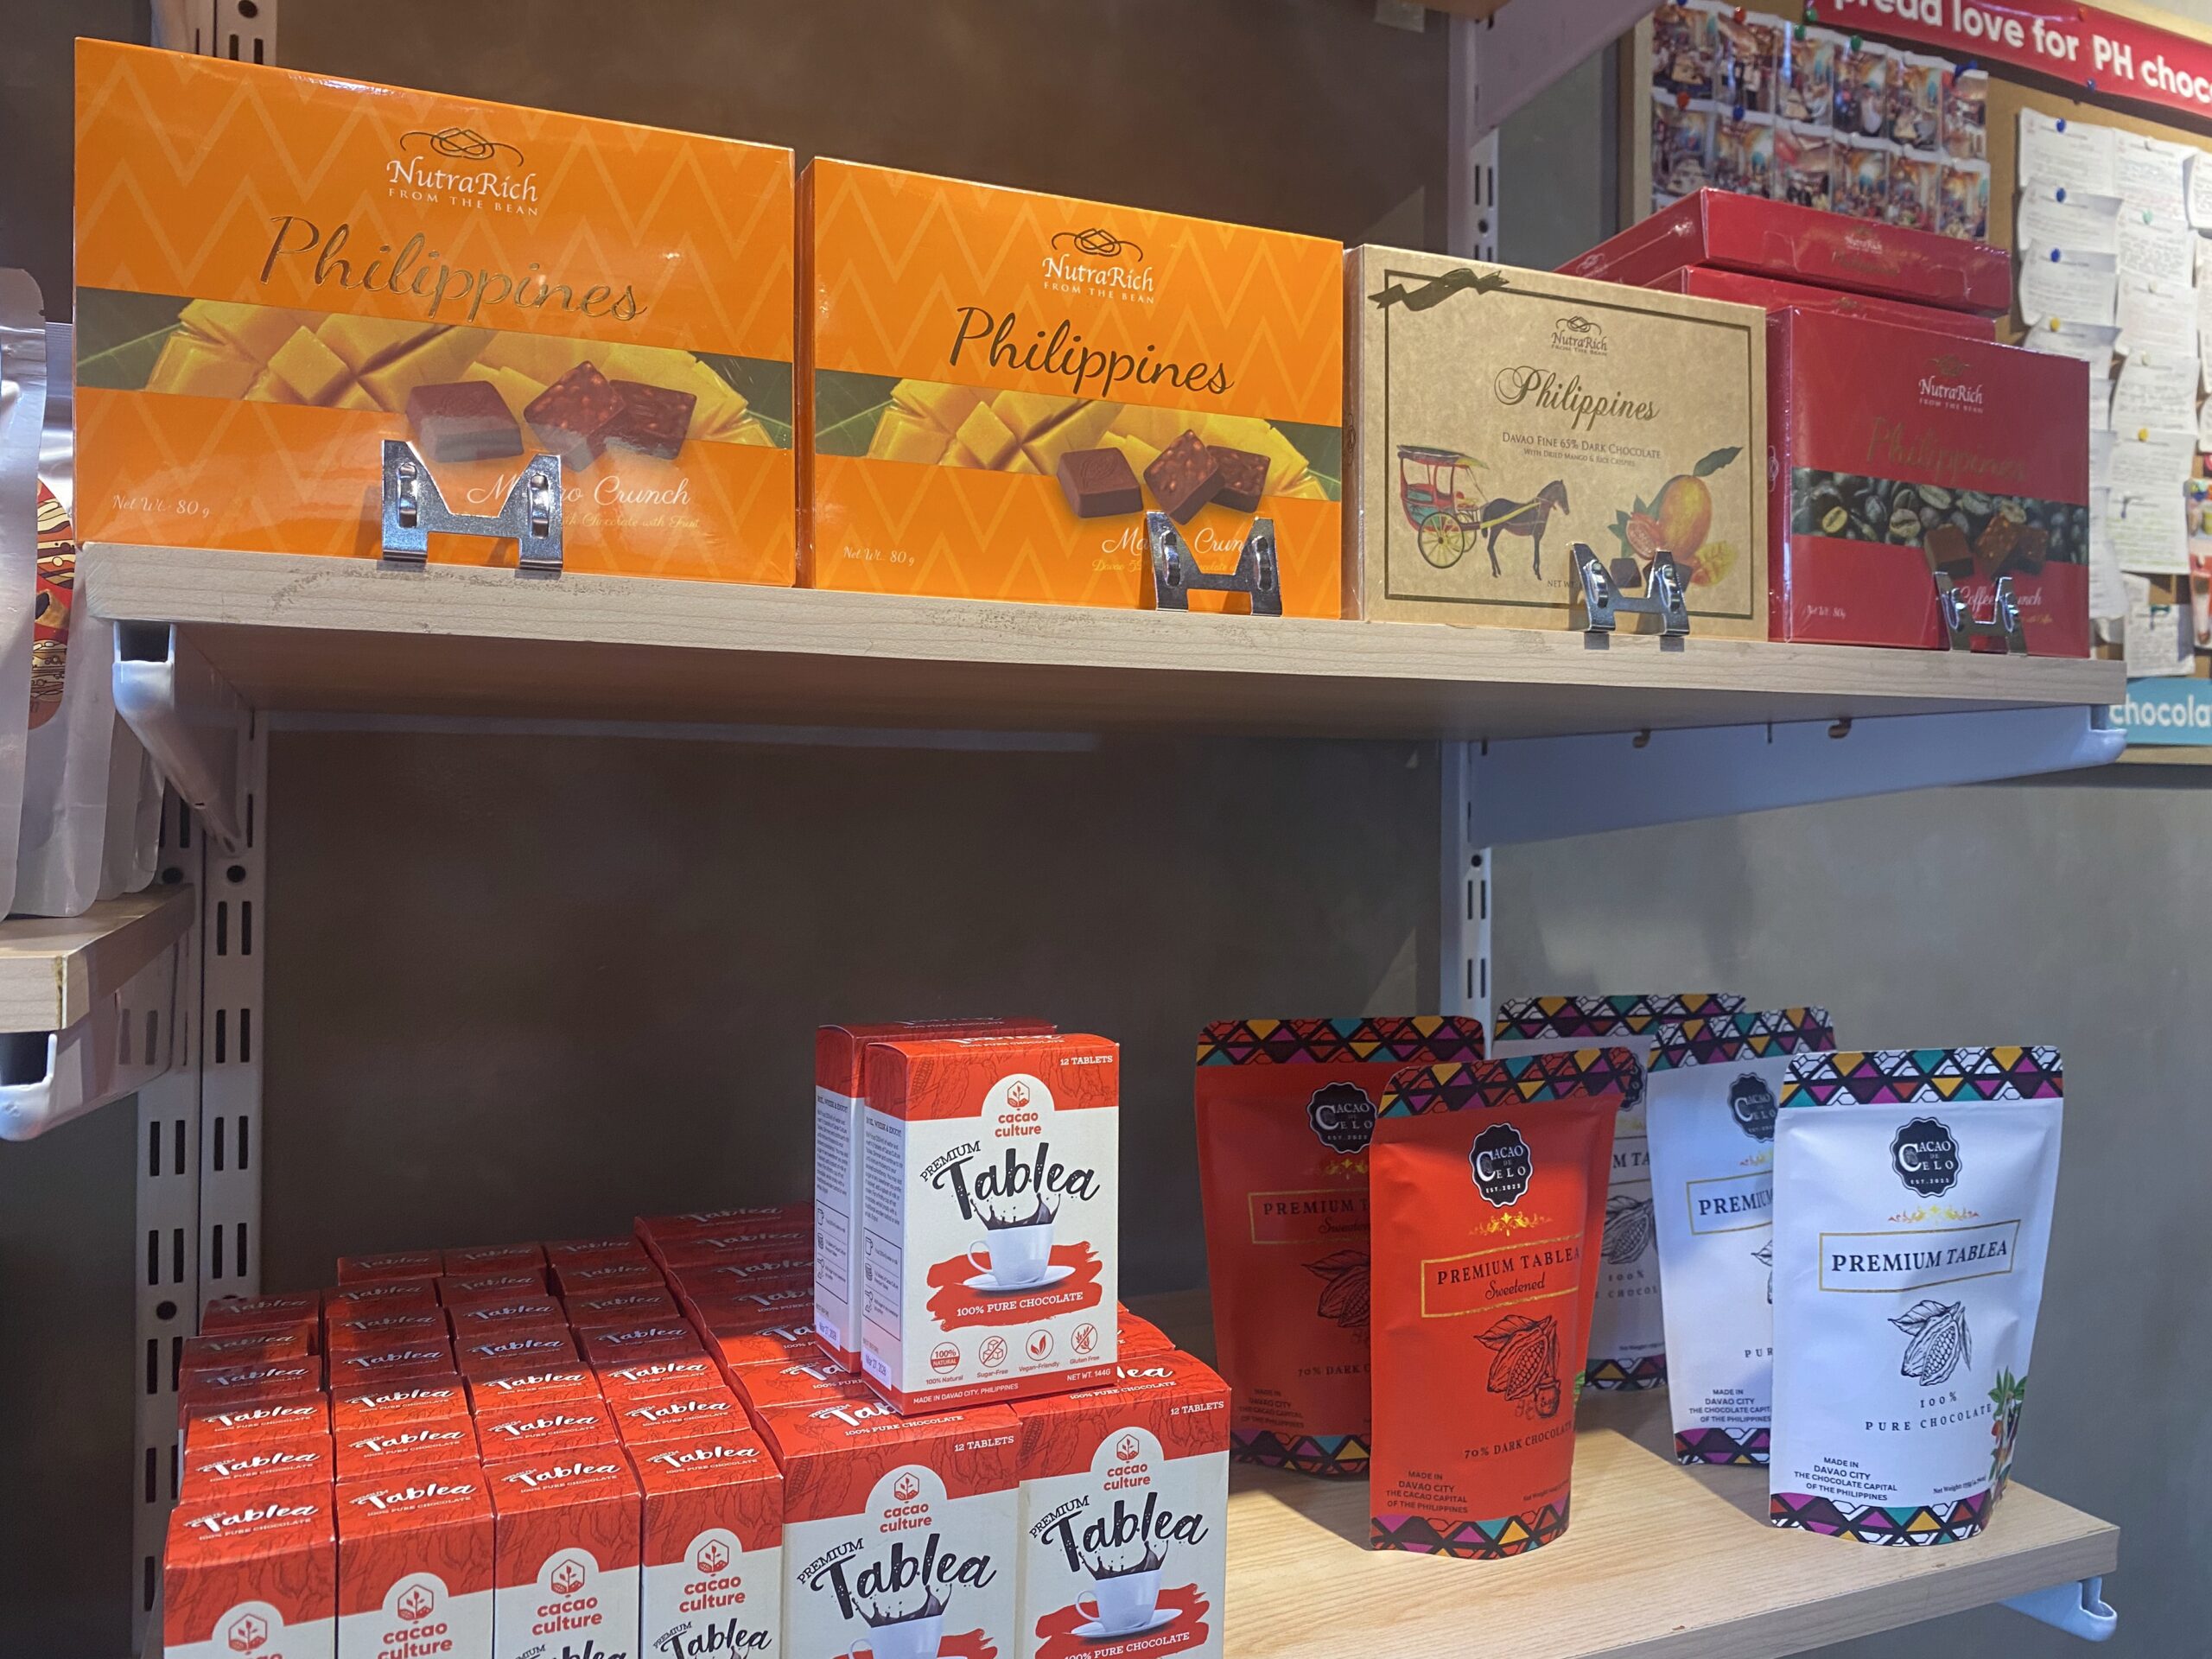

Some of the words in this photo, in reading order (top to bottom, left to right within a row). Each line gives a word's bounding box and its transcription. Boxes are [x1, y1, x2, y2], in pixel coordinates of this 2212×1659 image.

[1954, 8, 2024, 48] love
[2031, 19, 2077, 61] for
[2094, 34, 2134, 80] PH
[2141, 54, 2212, 104] choc
[386, 156, 538, 202] NutraRich
[389, 188, 438, 203] FROM
[449, 196, 484, 209] THE
[494, 201, 537, 216] BEAN
[260, 215, 647, 323] Philippines
[1042, 254, 1154, 292] NutraRich
[1044, 282, 1081, 295] FROM
[1089, 288, 1115, 299] THE
[1122, 293, 1154, 304] BEAN
[1551, 329, 1607, 351] NutraRich
[950, 307, 1234, 397] Philippines
[1494, 365, 1660, 431] Philippines
[1918, 376, 1984, 405] NutraRich
[1560, 438, 1579, 449] 65%
[594, 475, 690, 505] Crunch
[176, 499, 199, 515] 80
[889, 550, 906, 563] 80
[1548, 580, 1561, 588] NET
[1071, 1055, 1114, 1065] TABLETS
[998, 1112, 1039, 1123] cacao
[995, 1124, 1042, 1137] culture
[919, 1141, 982, 1182] PREMIUM
[932, 1142, 1100, 1220] Tablea
[1263, 1199, 1353, 1215] PREMIUM
[1832, 1250, 1942, 1272] PREMIUM
[1946, 1240, 2007, 1265] TABLEA
[1437, 1258, 1514, 1285] PREMIUM
[1521, 1247, 1580, 1269] TABLEA
[1485, 1272, 1545, 1300] Sweetened
[466, 1306, 554, 1319] Tablea
[957, 1306, 984, 1316] 100%
[987, 1301, 1017, 1313] PURE
[1019, 1292, 1084, 1308] CHOCOLATE
[598, 1328, 687, 1343] Tablea
[471, 1340, 564, 1356] Tablea
[934, 1349, 957, 1358] 100%
[1745, 1347, 1773, 1357] PUR
[347, 1351, 443, 1368] Tablea
[932, 1358, 957, 1367] NATURAL
[1018, 1361, 1060, 1372] Vegan-Friendly
[210, 1368, 309, 1386] Tablea
[614, 1363, 708, 1381] Tablea
[942, 1374, 963, 1382] Natural
[976, 1368, 1008, 1378] Sugar-Free
[1094, 1368, 1111, 1377] 144G
[1325, 1364, 1360, 1375] DARK
[489, 1373, 586, 1389] Tablea
[1121, 1381, 1177, 1393] CHOCOLATE
[351, 1389, 454, 1408] Tablea
[913, 1395, 931, 1404] MADE
[941, 1391, 963, 1401] DAVAO
[963, 1389, 979, 1397] CITY,
[980, 1383, 1018, 1395] PHILIPPINES
[1920, 1391, 1957, 1408] 100%
[208, 1406, 318, 1427] Tablea
[632, 1401, 731, 1421] Tablea
[1182, 1401, 1224, 1414] TABLETS
[495, 1415, 599, 1436] Tablea
[871, 1424, 900, 1433] PURE
[902, 1415, 965, 1428] CHOCOLATE
[1866, 1421, 1911, 1432] PURE
[1920, 1403, 1992, 1428] CHOCOLATE
[355, 1430, 466, 1452] Tablea
[967, 1435, 1014, 1450] TABLETS
[1465, 1447, 1490, 1459] 70%
[1494, 1439, 1522, 1455] DARK
[203, 1452, 320, 1476] Tablea
[654, 1446, 760, 1468] Tablea
[1823, 1457, 1847, 1467] MADE
[509, 1463, 620, 1487] Tablea
[1107, 1462, 1147, 1478] cacao
[1408, 1471, 1432, 1480] MADE
[1814, 1465, 1847, 1478] DAVAO
[1849, 1471, 1871, 1481] CITY
[1103, 1476, 1151, 1491] culture
[1398, 1480, 1432, 1491] DAVAO
[1433, 1484, 1455, 1493] CITY
[1811, 1473, 1862, 1489] CHOCOLATE
[1864, 1483, 1897, 1491] CAPITAL
[358, 1483, 477, 1510] Tablea
[1402, 1491, 1432, 1500] CACAO
[1433, 1494, 1467, 1503] CAPITAL
[1818, 1484, 1835, 1493] THE
[1837, 1488, 1887, 1501] PHILIPPINES
[883, 1502, 929, 1519] cacao
[1400, 1500, 1416, 1509] THE
[1417, 1502, 1468, 1513] PHILIPPINES
[191, 1504, 319, 1533] Tablea
[880, 1516, 932, 1533] culture
[1029, 1495, 1090, 1539] PREMIUM
[1041, 1491, 1209, 1573] Tablea
[797, 1537, 864, 1585] PREMIUM
[810, 1533, 997, 1619] Tablea
[684, 1576, 741, 1596] cacao
[537, 1596, 598, 1618] cacao
[679, 1592, 746, 1613] culture
[383, 1622, 448, 1645] cacao
[531, 1613, 602, 1637] culture
[652, 1621, 692, 1649] PREMIUM
[661, 1618, 772, 1659] Tablea
[1094, 1644, 1123, 1659] PURE
[1127, 1632, 1190, 1653] CHOCOLATE
